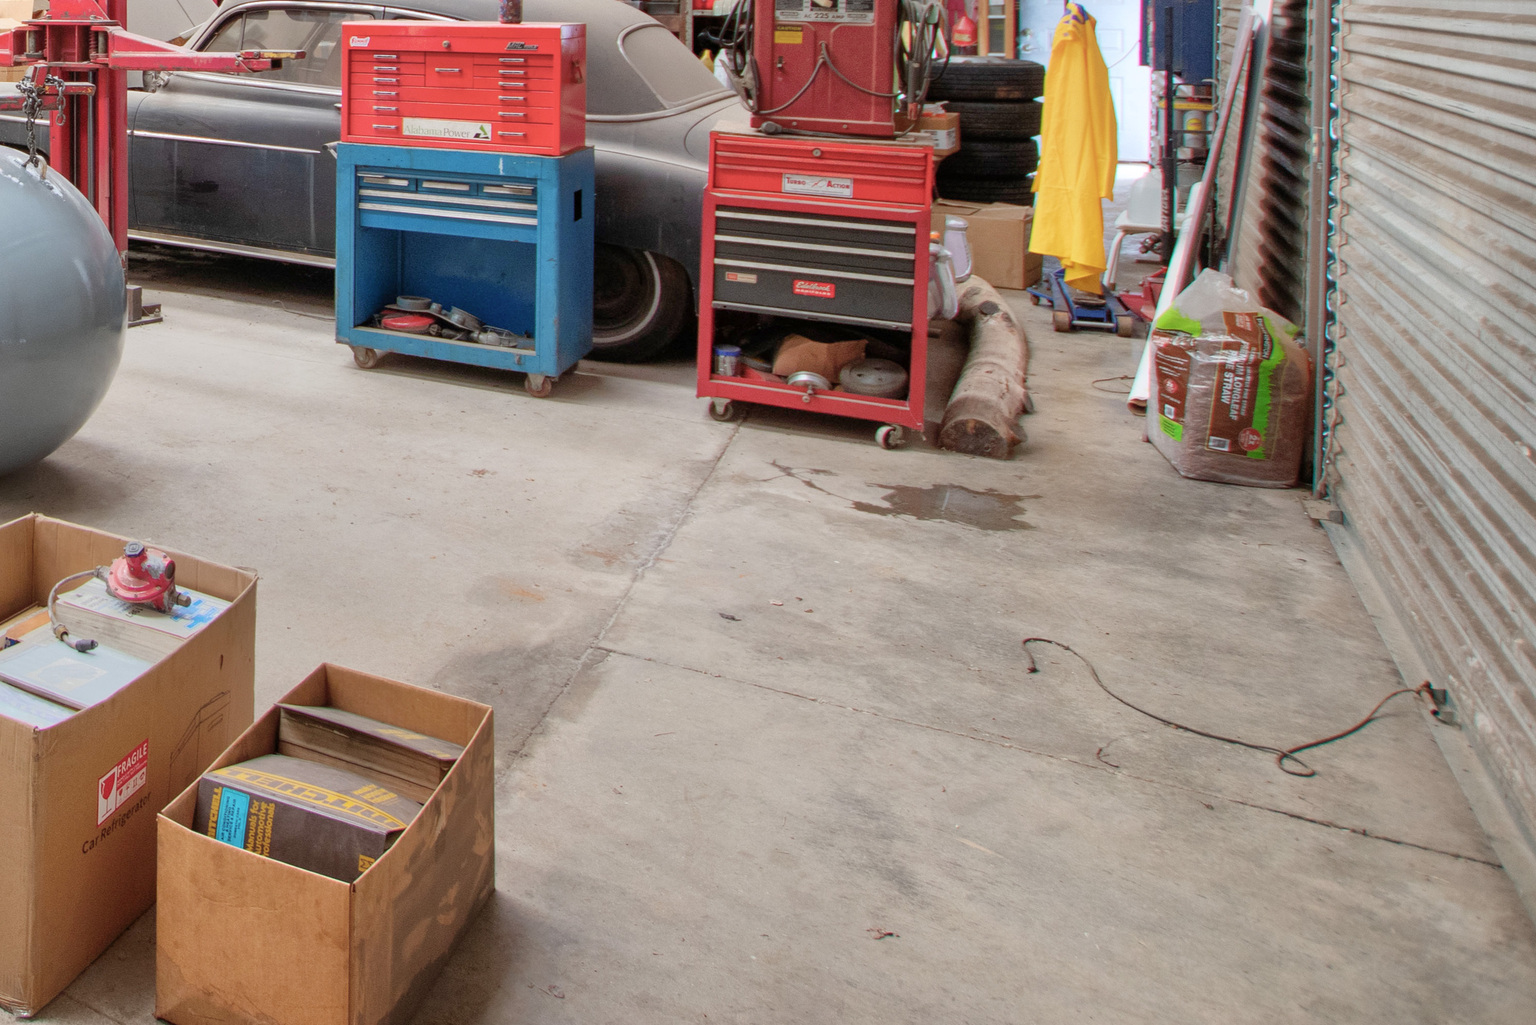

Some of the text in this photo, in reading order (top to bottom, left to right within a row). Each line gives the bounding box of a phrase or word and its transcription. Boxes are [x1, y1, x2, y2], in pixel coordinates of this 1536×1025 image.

[403, 124, 471, 139] Alabama Power
[1220, 371, 1234, 405] STRAW
[117, 743, 148, 777] FRAGILE
[82, 791, 152, 854] Car Refrigerator
[246, 799, 260, 852] Manuals for
[263, 803, 275, 857] rofessionals
